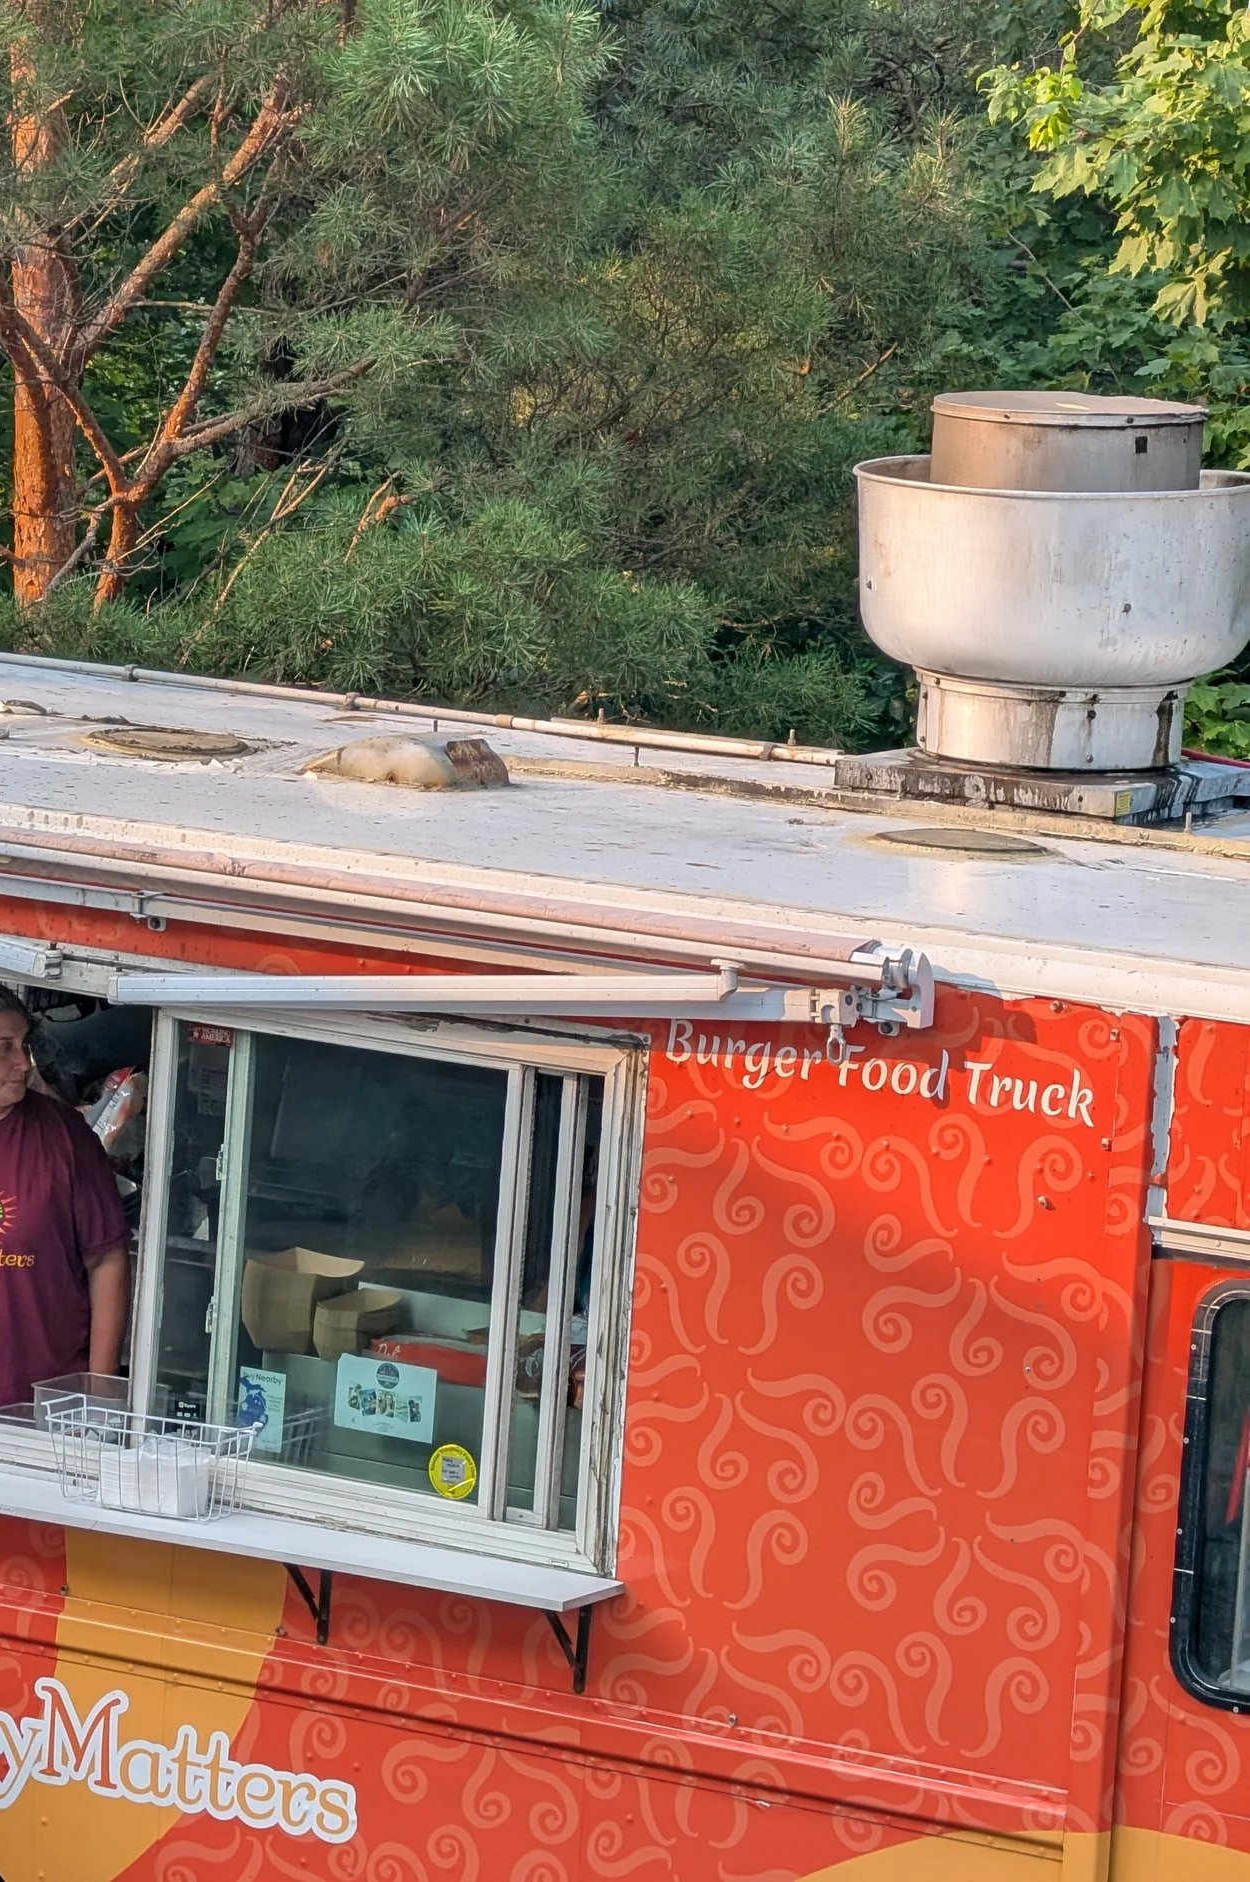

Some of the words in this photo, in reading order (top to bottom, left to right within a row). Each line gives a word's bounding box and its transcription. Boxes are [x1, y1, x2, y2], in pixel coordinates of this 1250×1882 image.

[666, 1018, 823, 1090] Burger
[838, 1045, 948, 1100] Food
[964, 1060, 1095, 1128] Truck
[255, 1373, 283, 1386] Nearby
